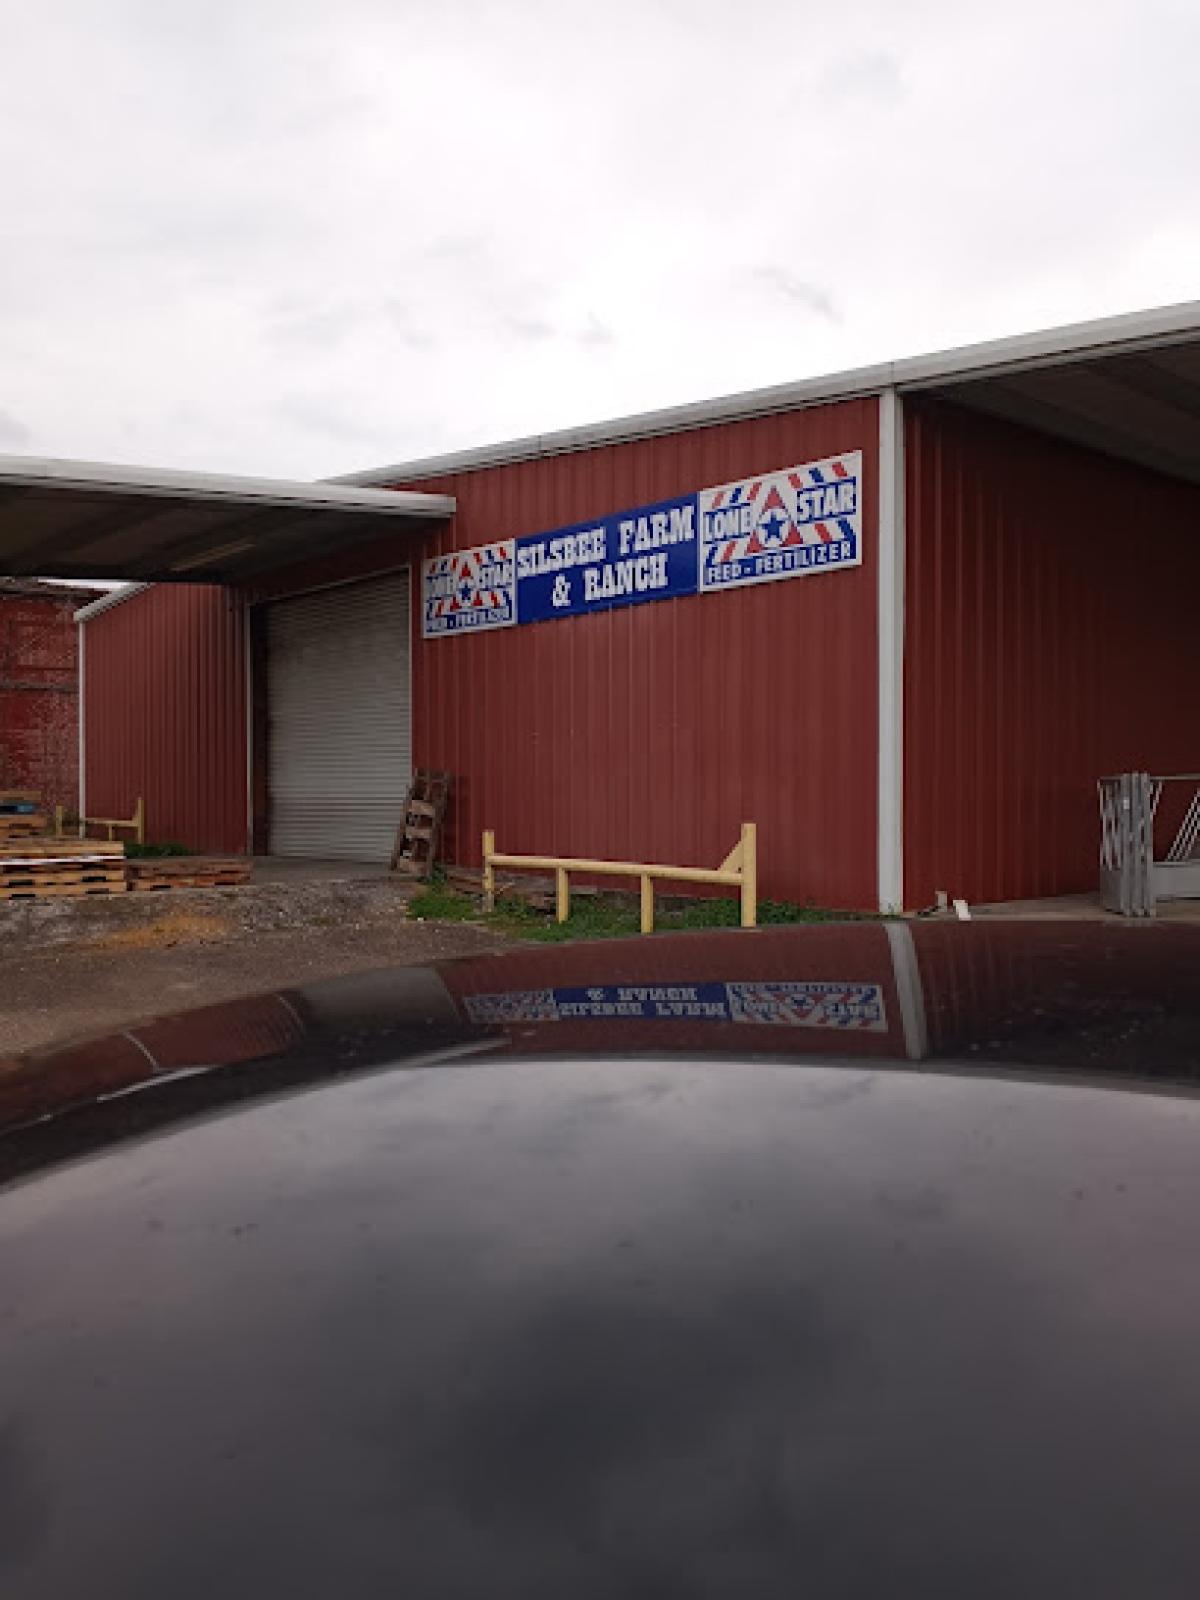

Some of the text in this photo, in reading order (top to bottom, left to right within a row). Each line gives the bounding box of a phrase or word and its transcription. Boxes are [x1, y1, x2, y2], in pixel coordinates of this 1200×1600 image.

[517, 505, 694, 579] SILSBEE FARM
[704, 481, 855, 542] LONE STAR
[552, 552, 669, 608] & RANCH
